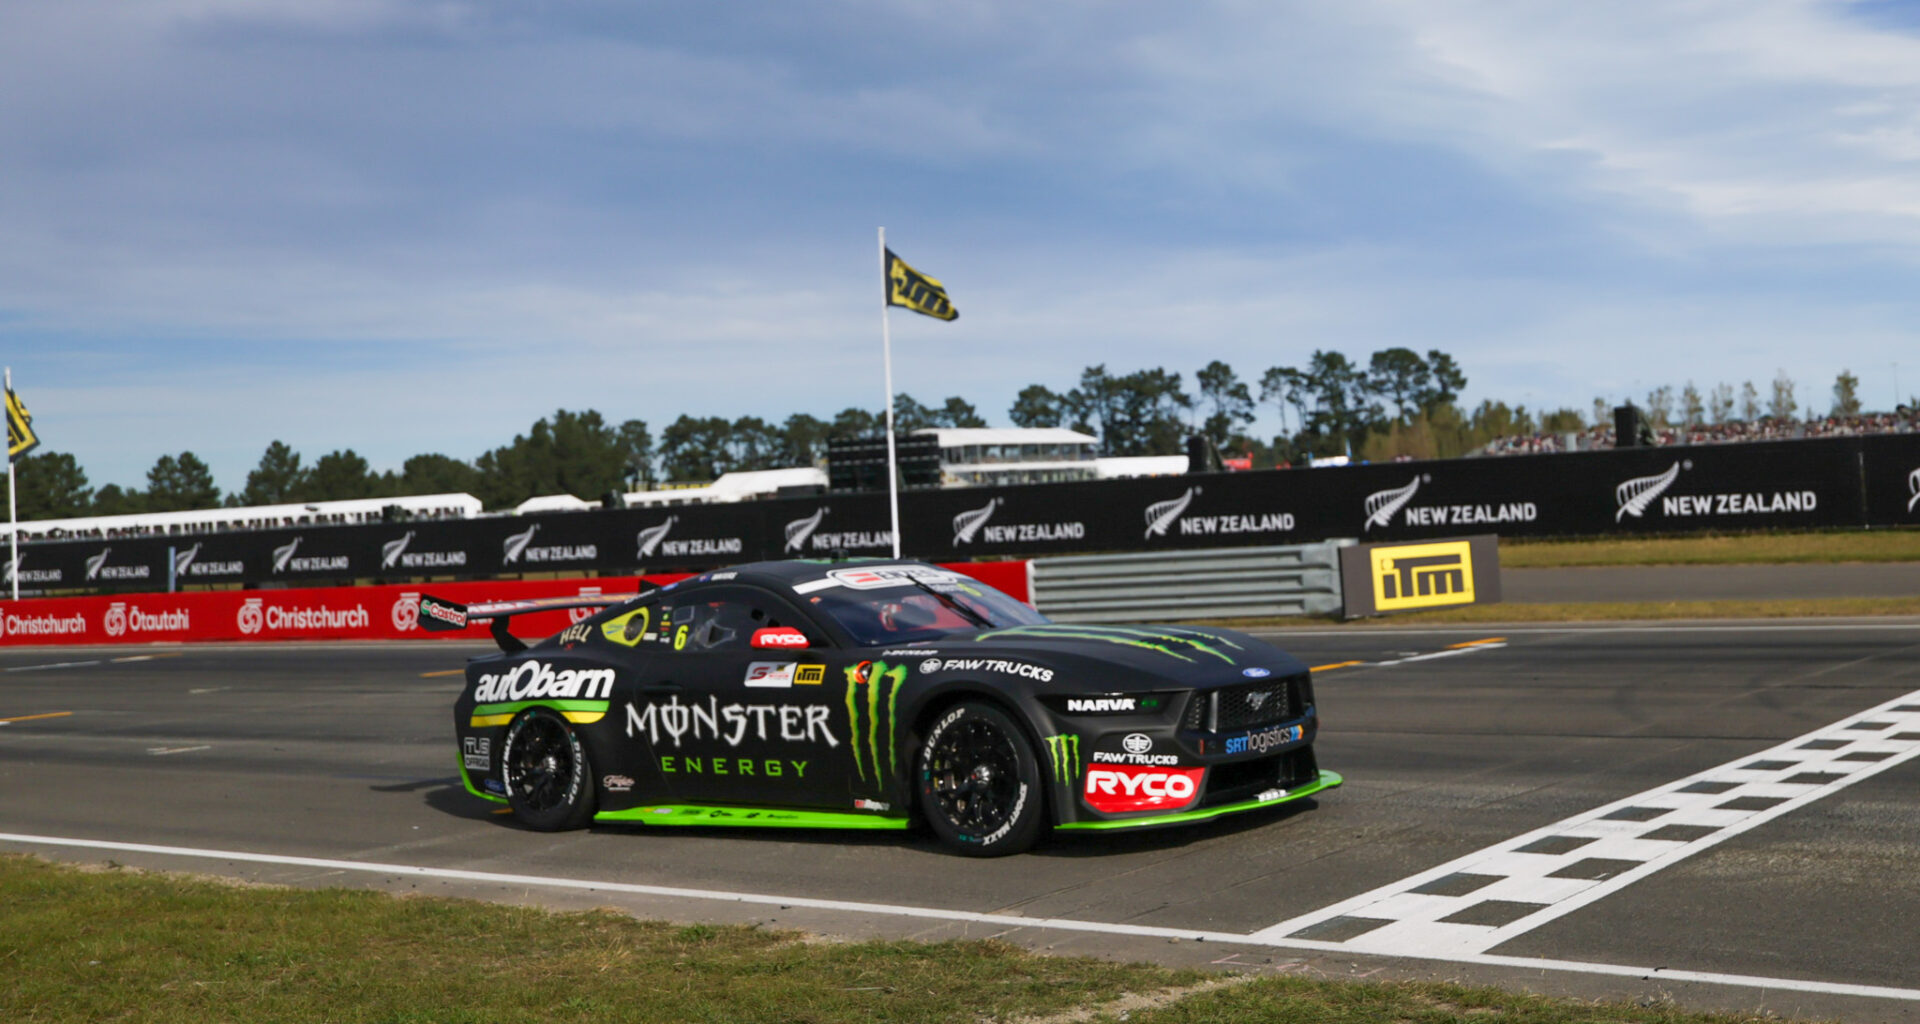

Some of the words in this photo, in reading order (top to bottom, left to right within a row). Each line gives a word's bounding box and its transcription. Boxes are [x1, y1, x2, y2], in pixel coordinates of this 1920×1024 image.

[1405, 507, 1447, 526] NEW
[1451, 502, 1537, 524] ZEALAND
[1663, 495, 1713, 516] NEW
[1715, 490, 1817, 514] ZEALAND
[984, 525, 1017, 542] NEW
[1018, 521, 1085, 541] ZEALAND
[1180, 516, 1217, 535] NEW
[1219, 512, 1295, 533] ZEALAND
[662, 541, 688, 556] NEW
[689, 538, 742, 554] ZEALAND
[812, 533, 841, 550] NEW
[842, 530, 894, 548] ZEALAN
[290, 558, 310, 571] NEW
[311, 556, 349, 570] ZEALAND
[402, 553, 423, 567] NEW
[424, 551, 466, 566] ZEALAND
[525, 547, 549, 562] NEW
[550, 545, 597, 560] ZEALAND
[101, 567, 117, 578] NEW
[118, 565, 150, 578] ZEALAND
[191, 563, 208, 574] NEW
[209, 561, 244, 574] ZEALAND
[1375, 547, 1471, 606] itm
[6, 613, 86, 635] Christchurch
[129, 605, 190, 631] Ōtautahi
[266, 604, 369, 630] Christchurch
[430, 602, 467, 628] Castrol
[559, 624, 592, 645] HELL
[673, 624, 689, 651] 6
[760, 634, 808, 645] RYCO
[942, 660, 986, 671] FAW
[985, 660, 1054, 682] TRUCKS
[1067, 698, 1134, 711] NARVA
[625, 695, 839, 748] MONSTER
[924, 708, 965, 761] DUNLOP
[660, 756, 808, 778] ENERGY
[1093, 751, 1127, 762] FAW
[1126, 753, 1178, 765] TRUCKS
[568, 742, 583, 805] DUNLOP
[1087, 770, 1194, 798] RYCO
[982, 821, 1011, 846] MAXX
